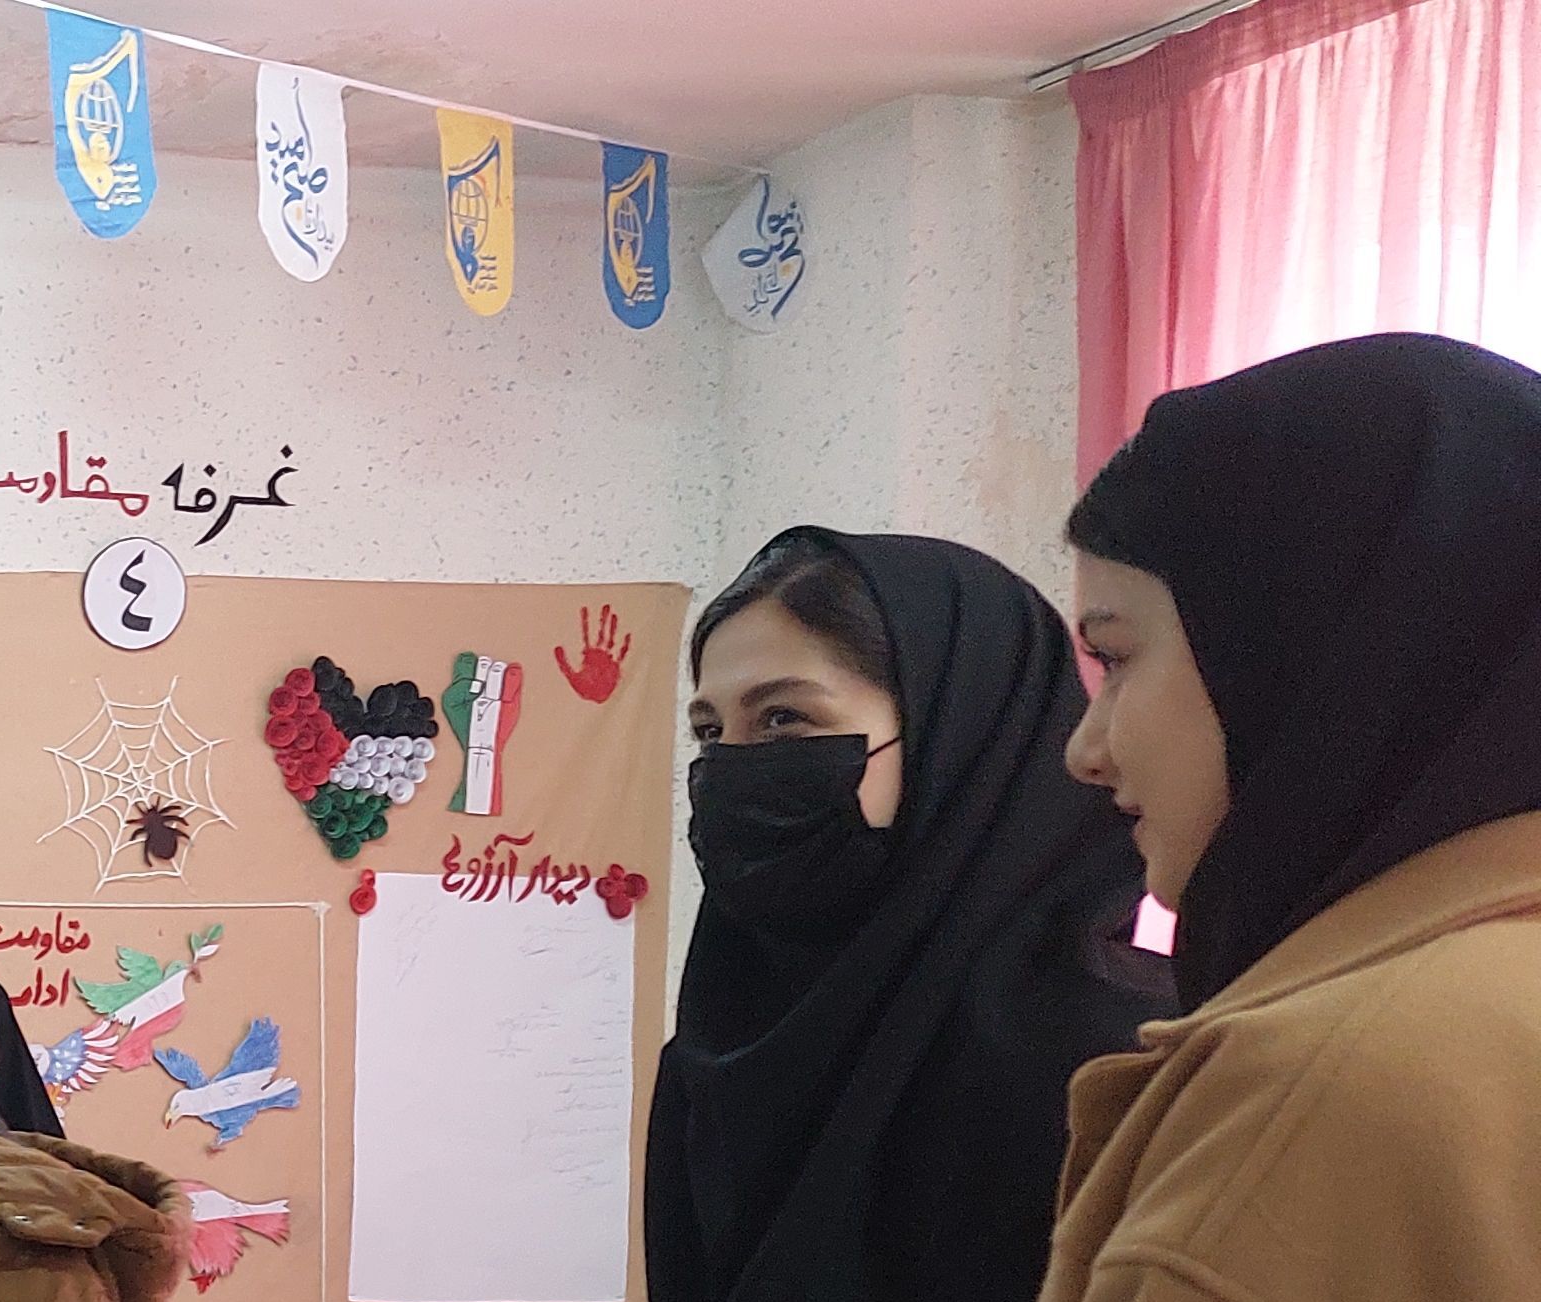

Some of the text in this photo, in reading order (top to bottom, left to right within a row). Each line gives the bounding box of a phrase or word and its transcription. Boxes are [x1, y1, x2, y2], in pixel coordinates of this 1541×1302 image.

[161, 445, 299, 547] غرفه
[441, 830, 535, 903] آرزوها
[9, 966, 70, 1007] ادام
